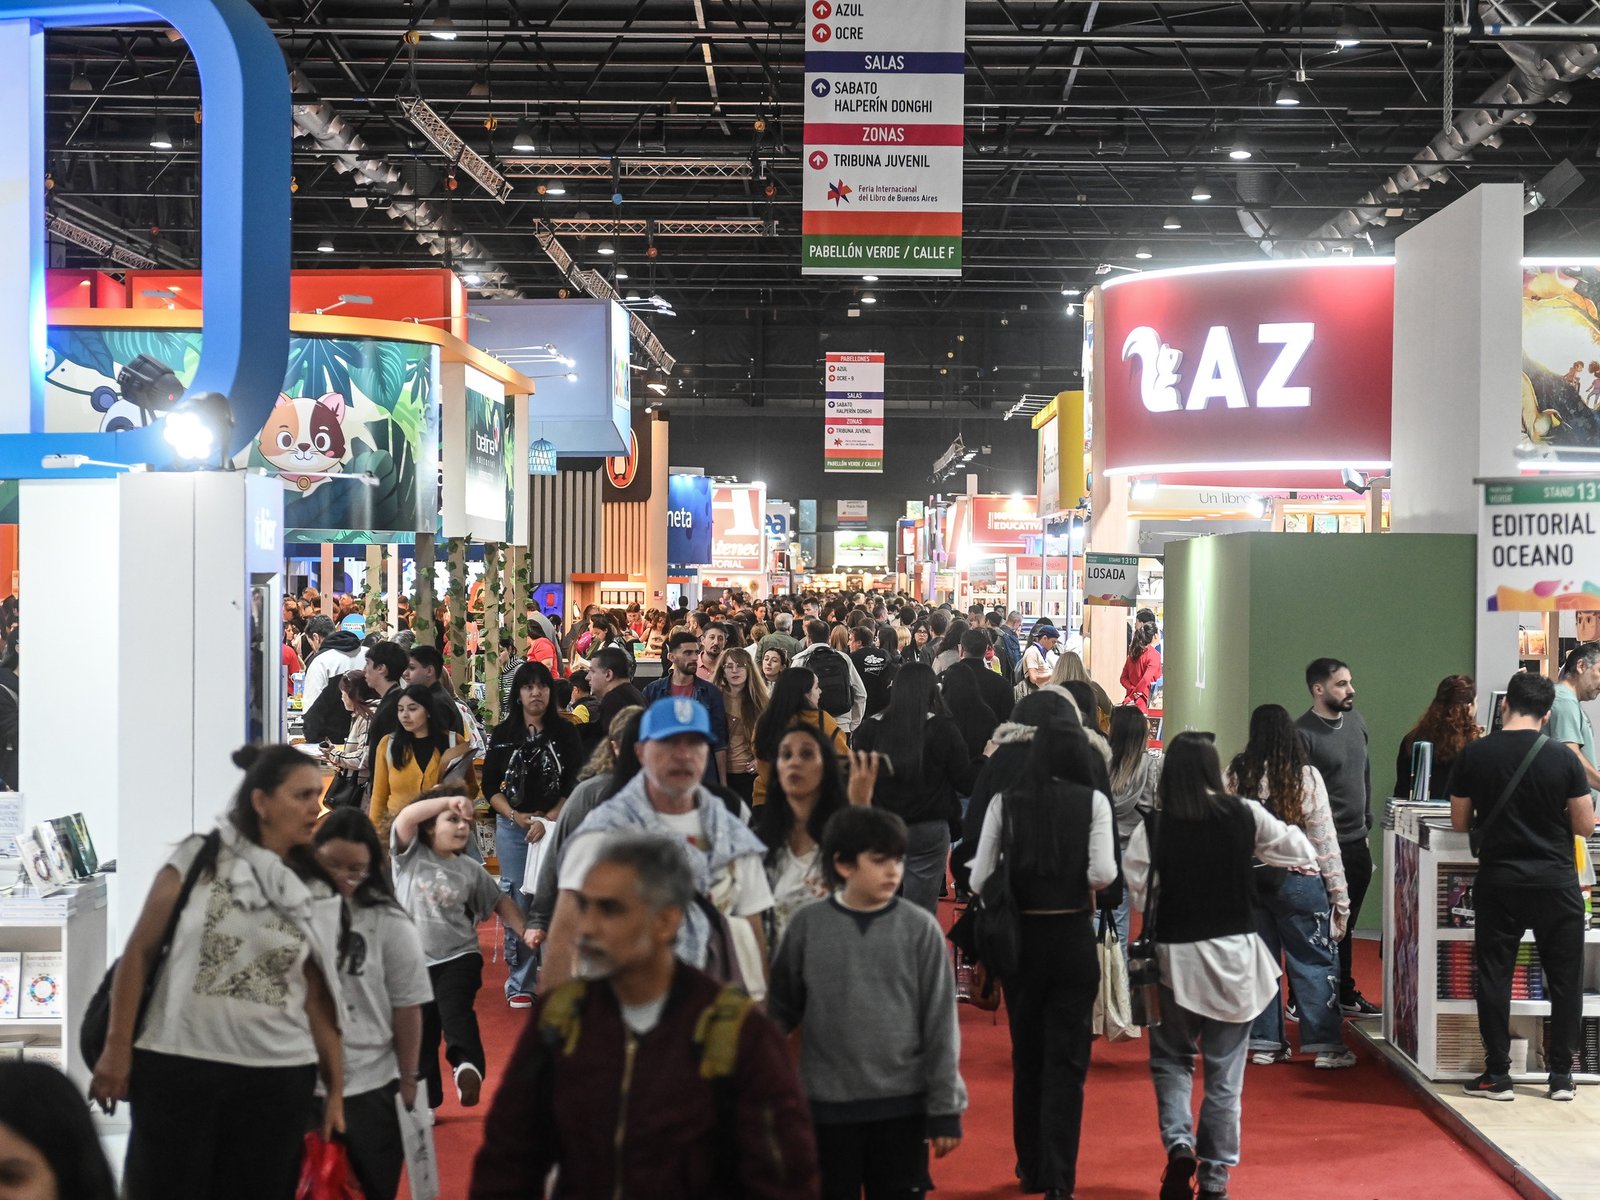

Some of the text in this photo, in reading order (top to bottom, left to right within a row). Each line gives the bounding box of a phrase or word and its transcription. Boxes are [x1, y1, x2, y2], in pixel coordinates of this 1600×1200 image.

[835, 3, 864, 17] AZUL
[835, 26, 864, 40] OCRE
[864, 55, 905, 70] SALAS
[834, 81, 878, 95] SABATO
[834, 96, 933, 113] HALPERÍN DONGHI
[862, 127, 905, 142] ZONAS
[834, 154, 930, 168] TRIBUNA JUVENIL
[858, 184, 918, 194] Feria Internacional
[858, 193, 938, 203] del Libro de Buenos Aires
[809, 242, 955, 259] PABELLÓN VERDE / CALLE F
[1185, 322, 1316, 410] AZ
[1199, 492, 1217, 504] Un
[1577, 482, 1600, 500] 13
[994, 521, 1042, 530] EDUCATIV
[1492, 513, 1596, 537] EDITORIAL
[1121, 557, 1137, 565] 1310
[1493, 544, 1574, 567] OCEANO
[1088, 567, 1126, 580] LOSADA
